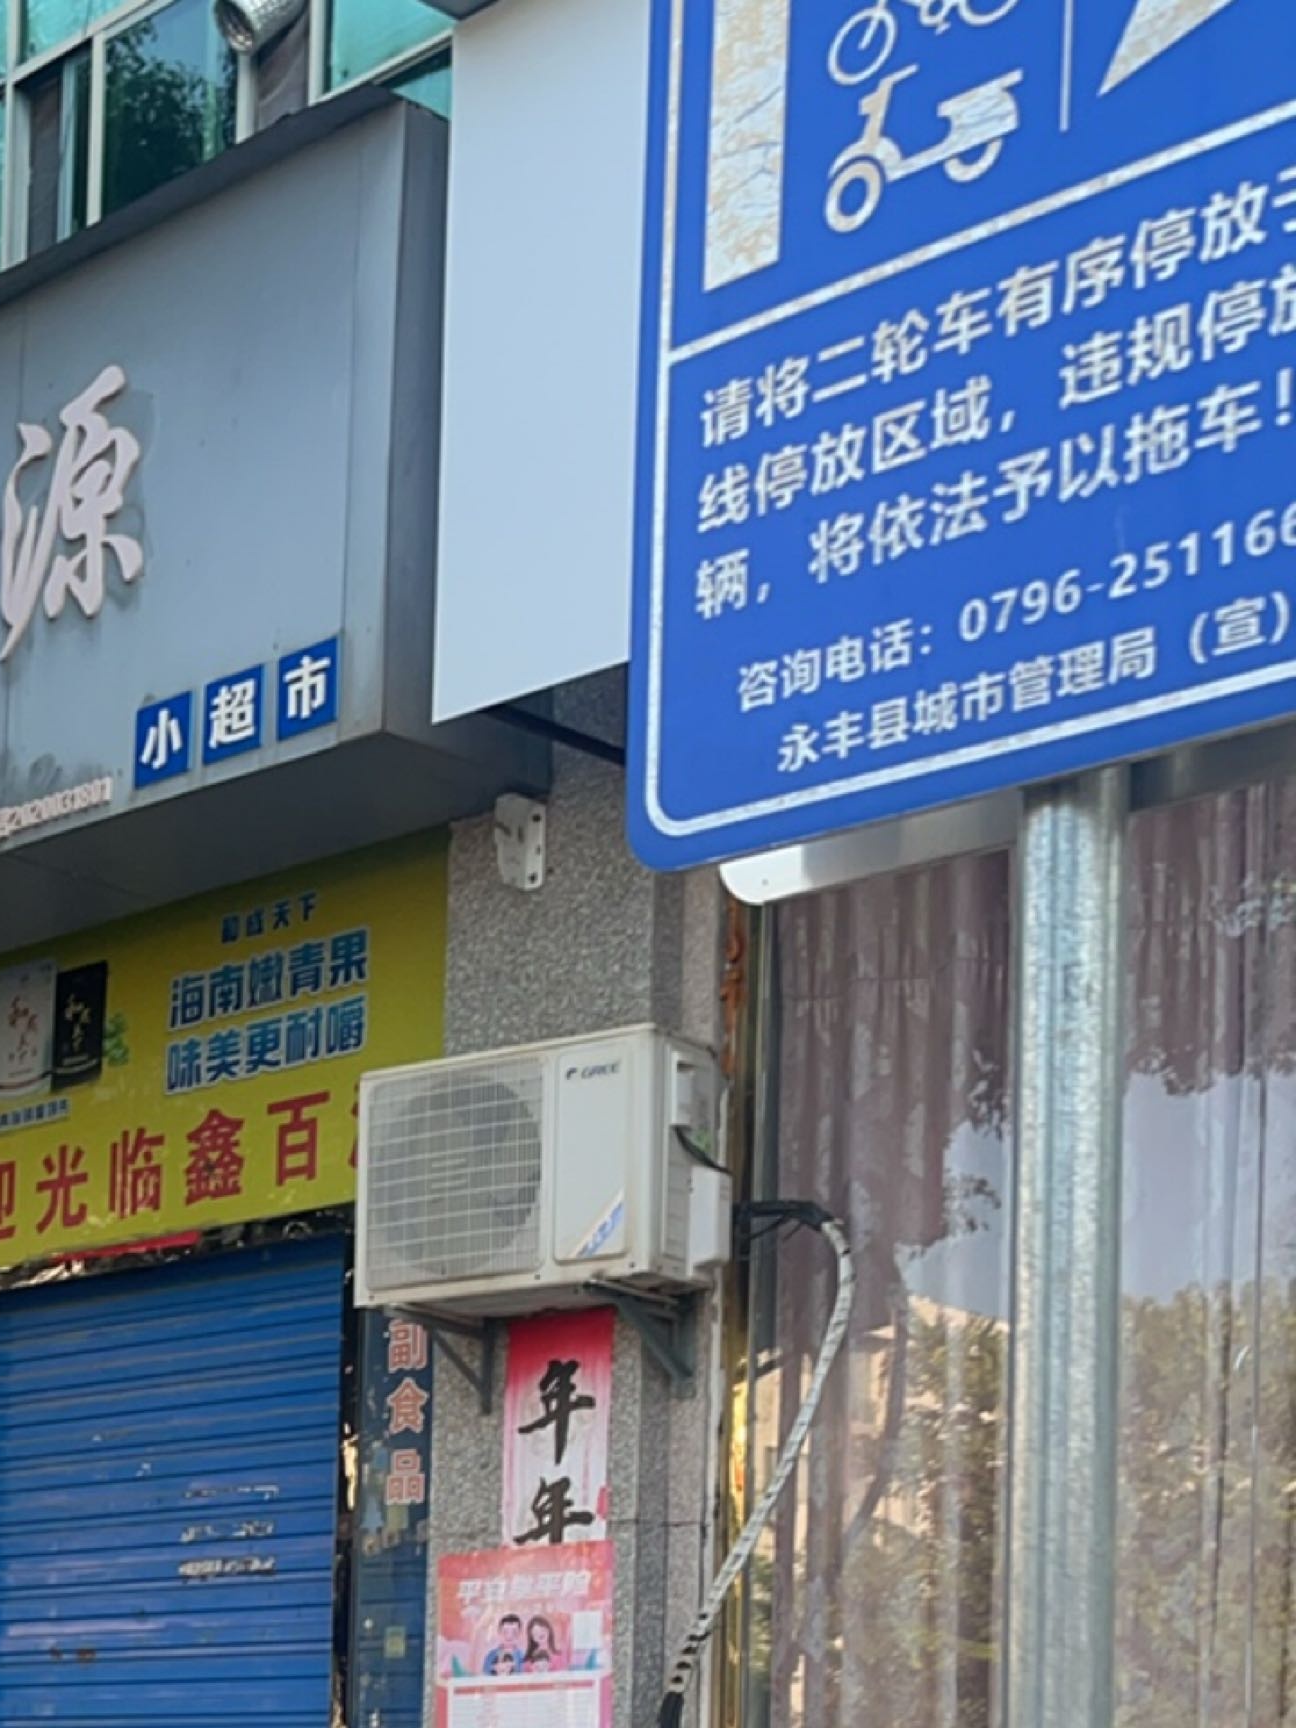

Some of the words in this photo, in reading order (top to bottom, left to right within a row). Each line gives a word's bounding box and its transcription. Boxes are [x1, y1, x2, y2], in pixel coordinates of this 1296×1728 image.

[139, 656, 333, 769] 小超市
[168, 926, 371, 1032] 海南嫩青果
[163, 994, 369, 1096] 味美更耐嚼
[385, 1318, 430, 1505] 副食品
[512, 1359, 597, 1543] 年年
